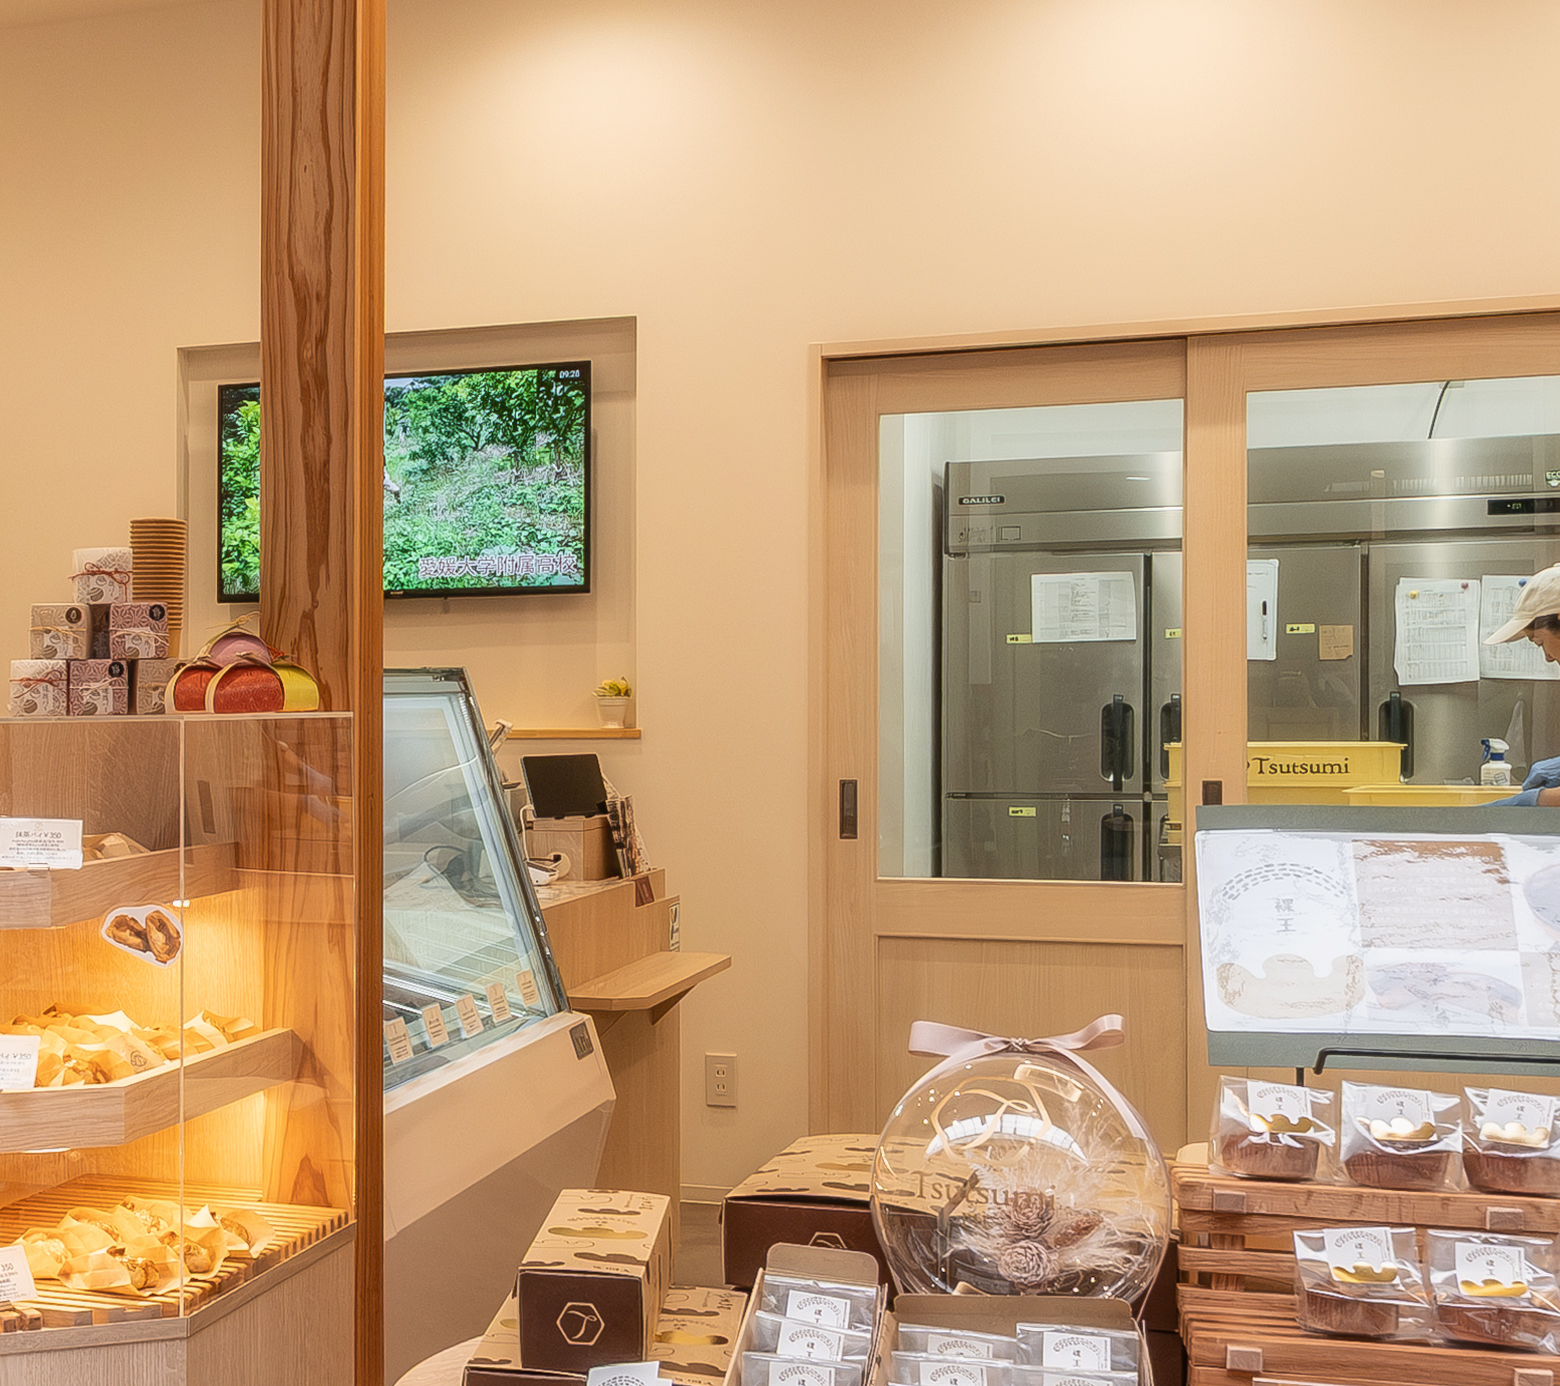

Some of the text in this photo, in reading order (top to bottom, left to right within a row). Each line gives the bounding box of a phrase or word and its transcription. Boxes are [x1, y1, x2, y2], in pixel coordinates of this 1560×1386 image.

[961, 496, 1001, 504] GALILEI
[419, 553, 578, 580] 愛媛大学附属高校
[1251, 757, 1351, 776] Tsutsumi
[1274, 897, 1297, 933] 裸王
